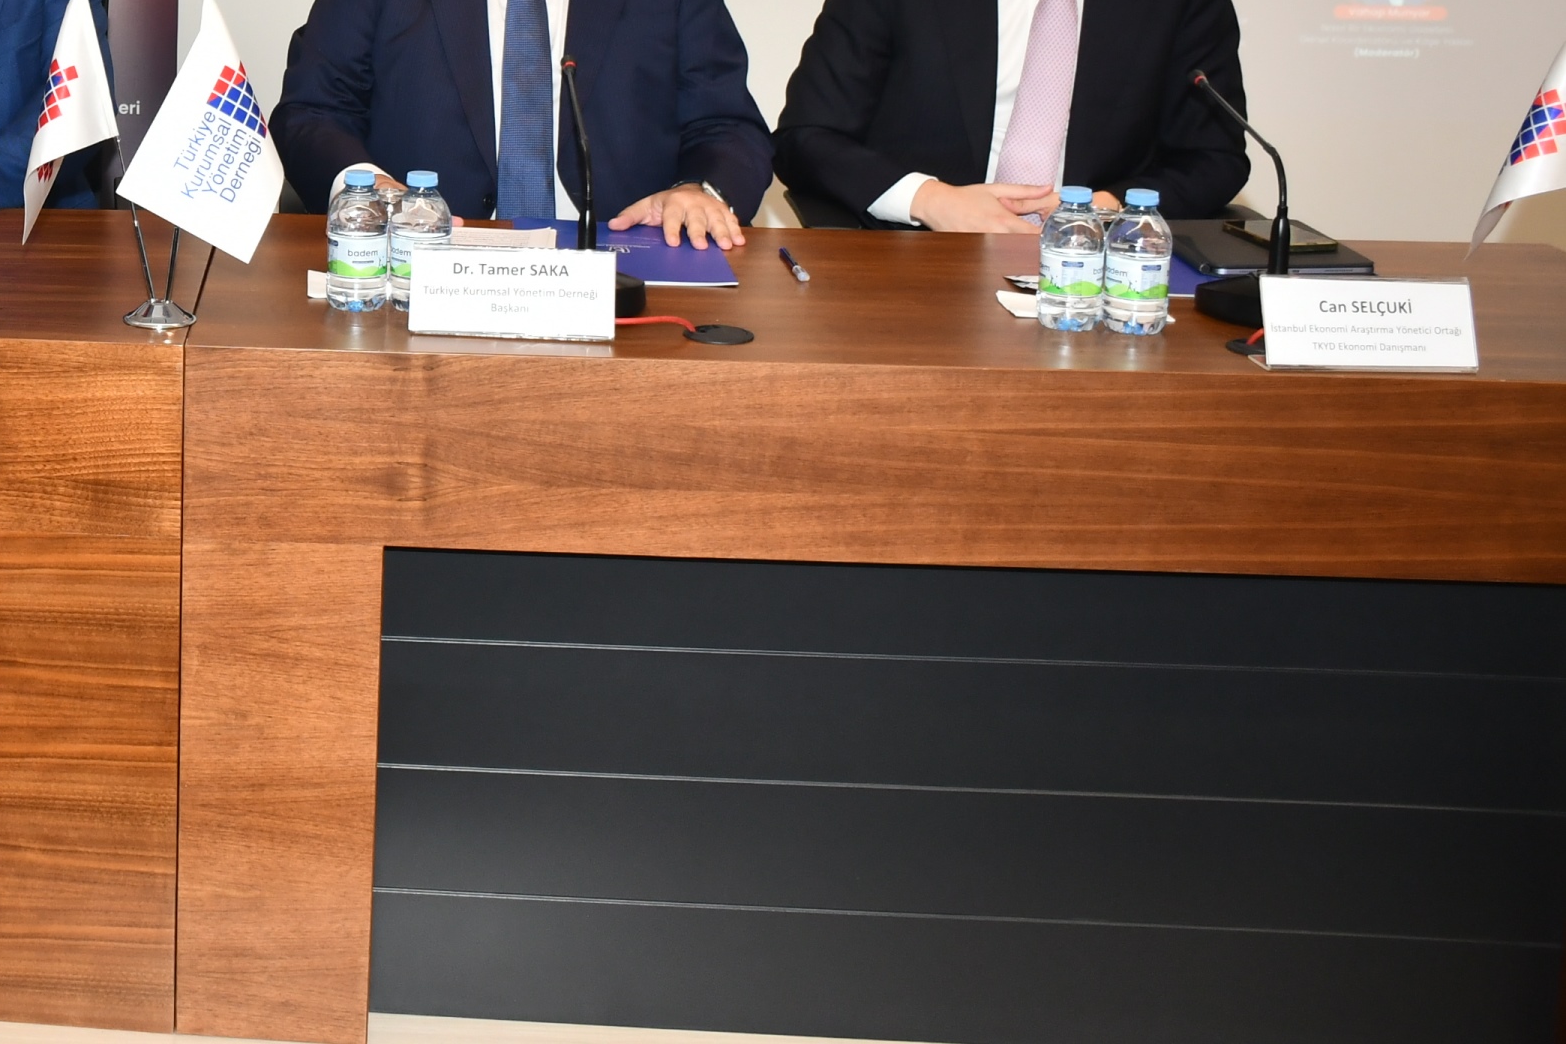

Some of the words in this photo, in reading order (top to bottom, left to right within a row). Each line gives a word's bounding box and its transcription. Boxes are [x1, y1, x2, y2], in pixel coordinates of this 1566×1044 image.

[173, 111, 216, 170] Türkiye
[180, 117, 232, 199] Kurumsal
[201, 128, 247, 194] Yönetim
[219, 134, 262, 203] Derneği
[347, 249, 379, 257] badem
[453, 262, 474, 275] Dr.
[479, 263, 525, 276] Tamer
[530, 264, 569, 277] SAKA
[423, 285, 461, 298] Türkiye
[463, 286, 510, 297] Kurumsal
[513, 287, 555, 298] Yönetim
[559, 288, 598, 301] Derneği
[490, 303, 529, 315] Başkanı
[1319, 300, 1347, 313] Can
[1351, 298, 1412, 316] SELÇUKİ
[1270, 323, 1307, 333] İstanbul
[1309, 324, 1348, 334] Ekonomi
[1350, 325, 1394, 336] Araştırma
[1396, 325, 1432, 335] Yönetici
[1434, 325, 1462, 337] Ortağı
[1312, 342, 1336, 351] TKYD
[1338, 342, 1377, 352] Ekonomi
[1379, 343, 1426, 354] Danışmanı
